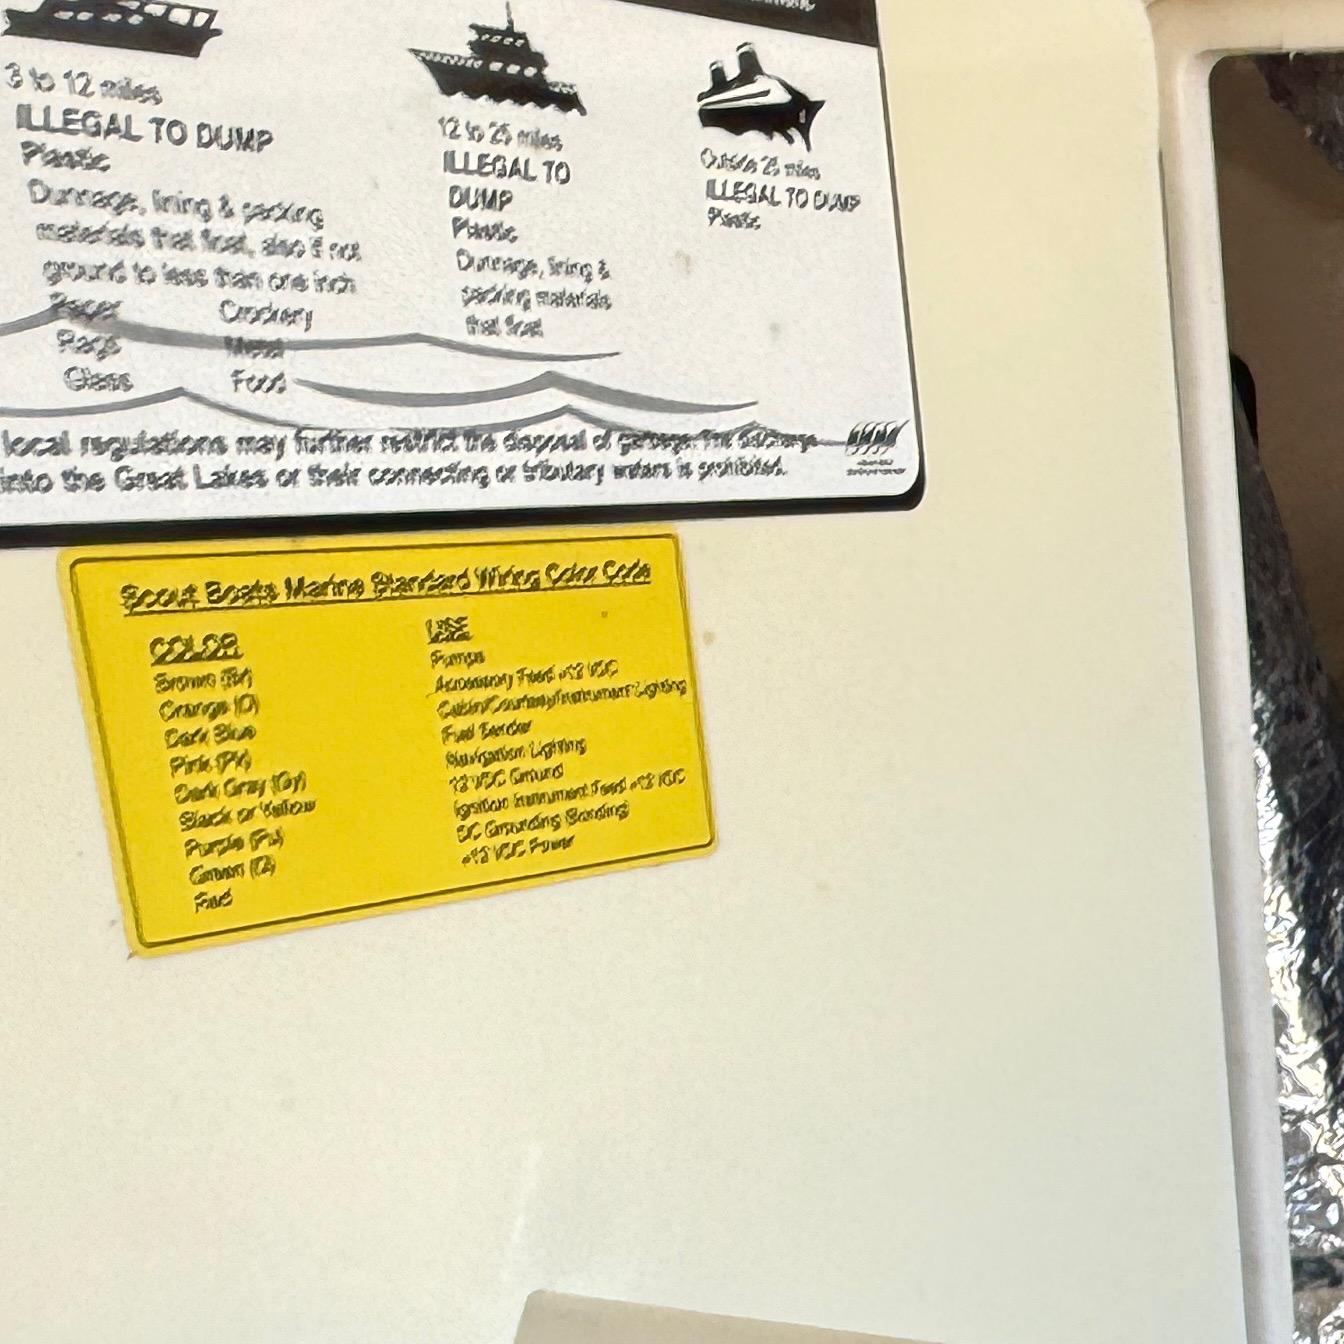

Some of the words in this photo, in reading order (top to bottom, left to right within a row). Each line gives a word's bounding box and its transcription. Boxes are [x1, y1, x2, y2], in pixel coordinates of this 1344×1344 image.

[5, 62, 23, 89] 3
[63, 69, 95, 97] 12
[16, 104, 144, 141] ILLEGAL
[148, 117, 188, 146] TO
[197, 122, 274, 152] DUMP
[438, 117, 461, 139] 12
[443, 150, 537, 182] ILLEGAL
[543, 160, 571, 185] TO
[449, 185, 513, 211] DUMP
[706, 179, 781, 207] ILLEGAL
[785, 187, 808, 208] TO
[814, 190, 861, 212] DUMP
[285, 574, 364, 600] Marine
